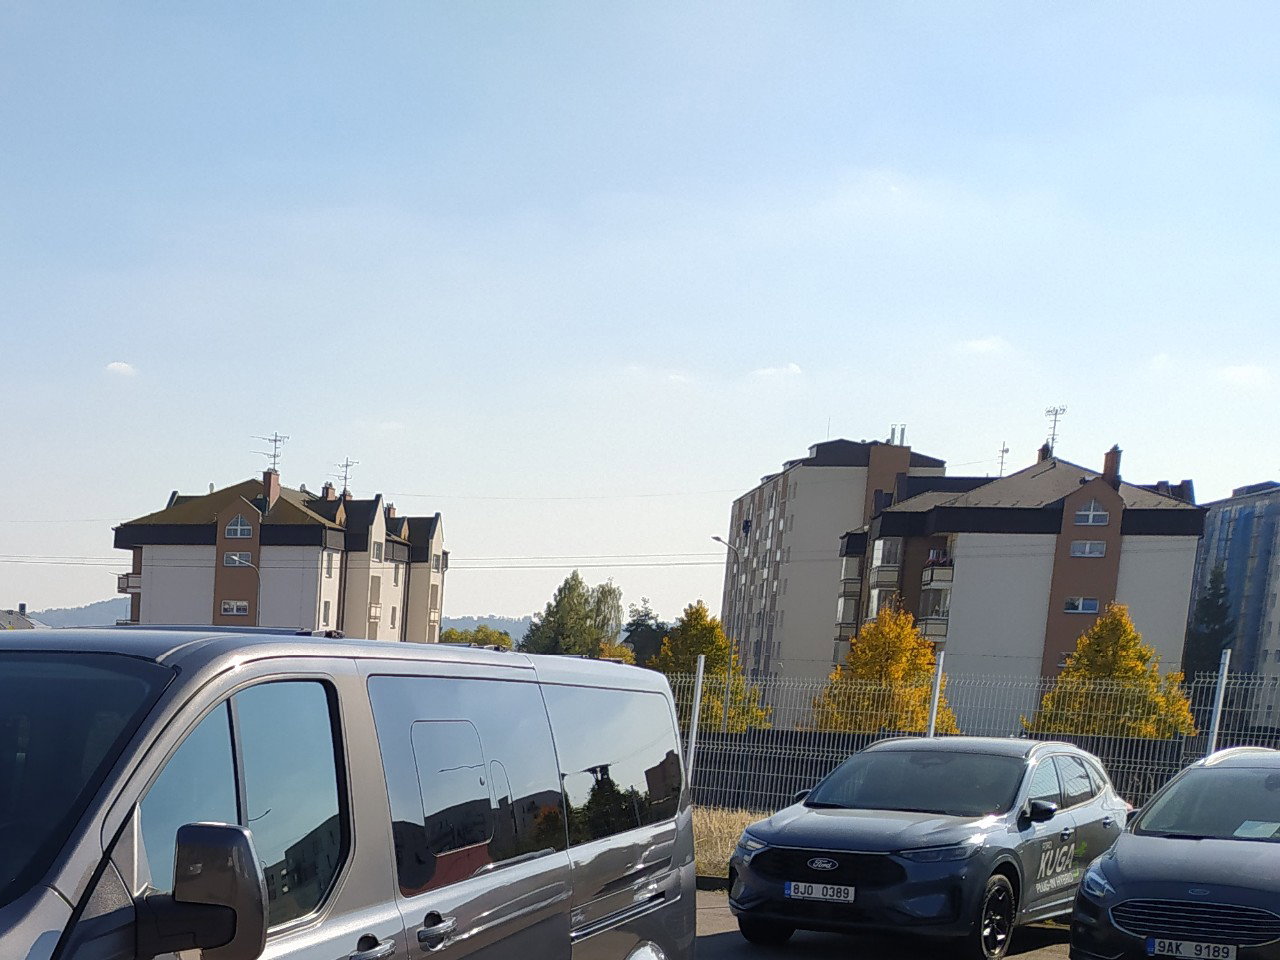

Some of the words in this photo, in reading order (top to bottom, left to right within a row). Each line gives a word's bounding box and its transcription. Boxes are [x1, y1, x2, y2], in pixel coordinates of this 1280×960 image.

[1037, 843, 1075, 879] KUGA
[821, 886, 849, 898] 0389
[1158, 941, 1182, 955] 9AK
[1194, 944, 1229, 958] 9189
